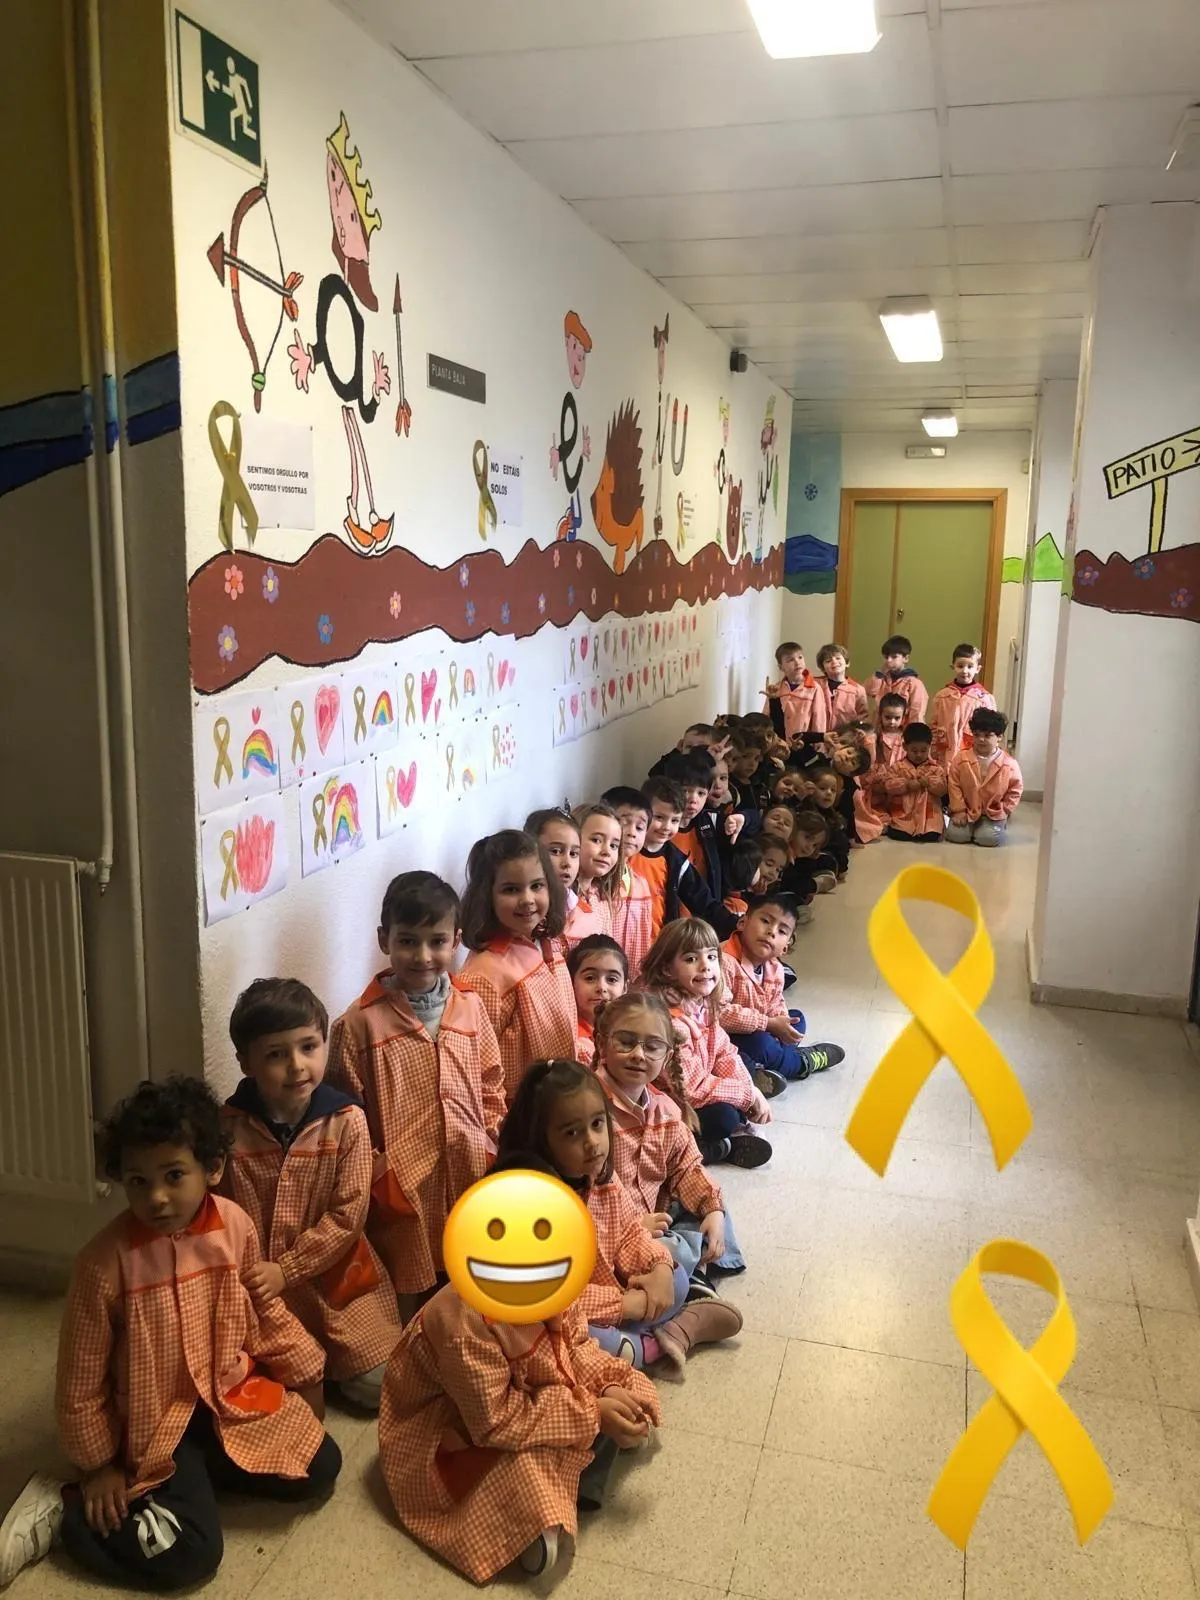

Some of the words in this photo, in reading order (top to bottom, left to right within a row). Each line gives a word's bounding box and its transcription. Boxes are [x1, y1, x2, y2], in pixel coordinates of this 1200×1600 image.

[247, 465, 275, 475] SENTIMOS
[276, 468, 298, 477] ORGULLO
[298, 471, 309, 479] POR
[490, 461, 500, 474] NO
[1112, 446, 1176, 489] PATIO
[248, 483, 277, 492] VOSOTROS
[281, 486, 307, 494] VOSOTRAS
[490, 483, 508, 496] SOLOS
